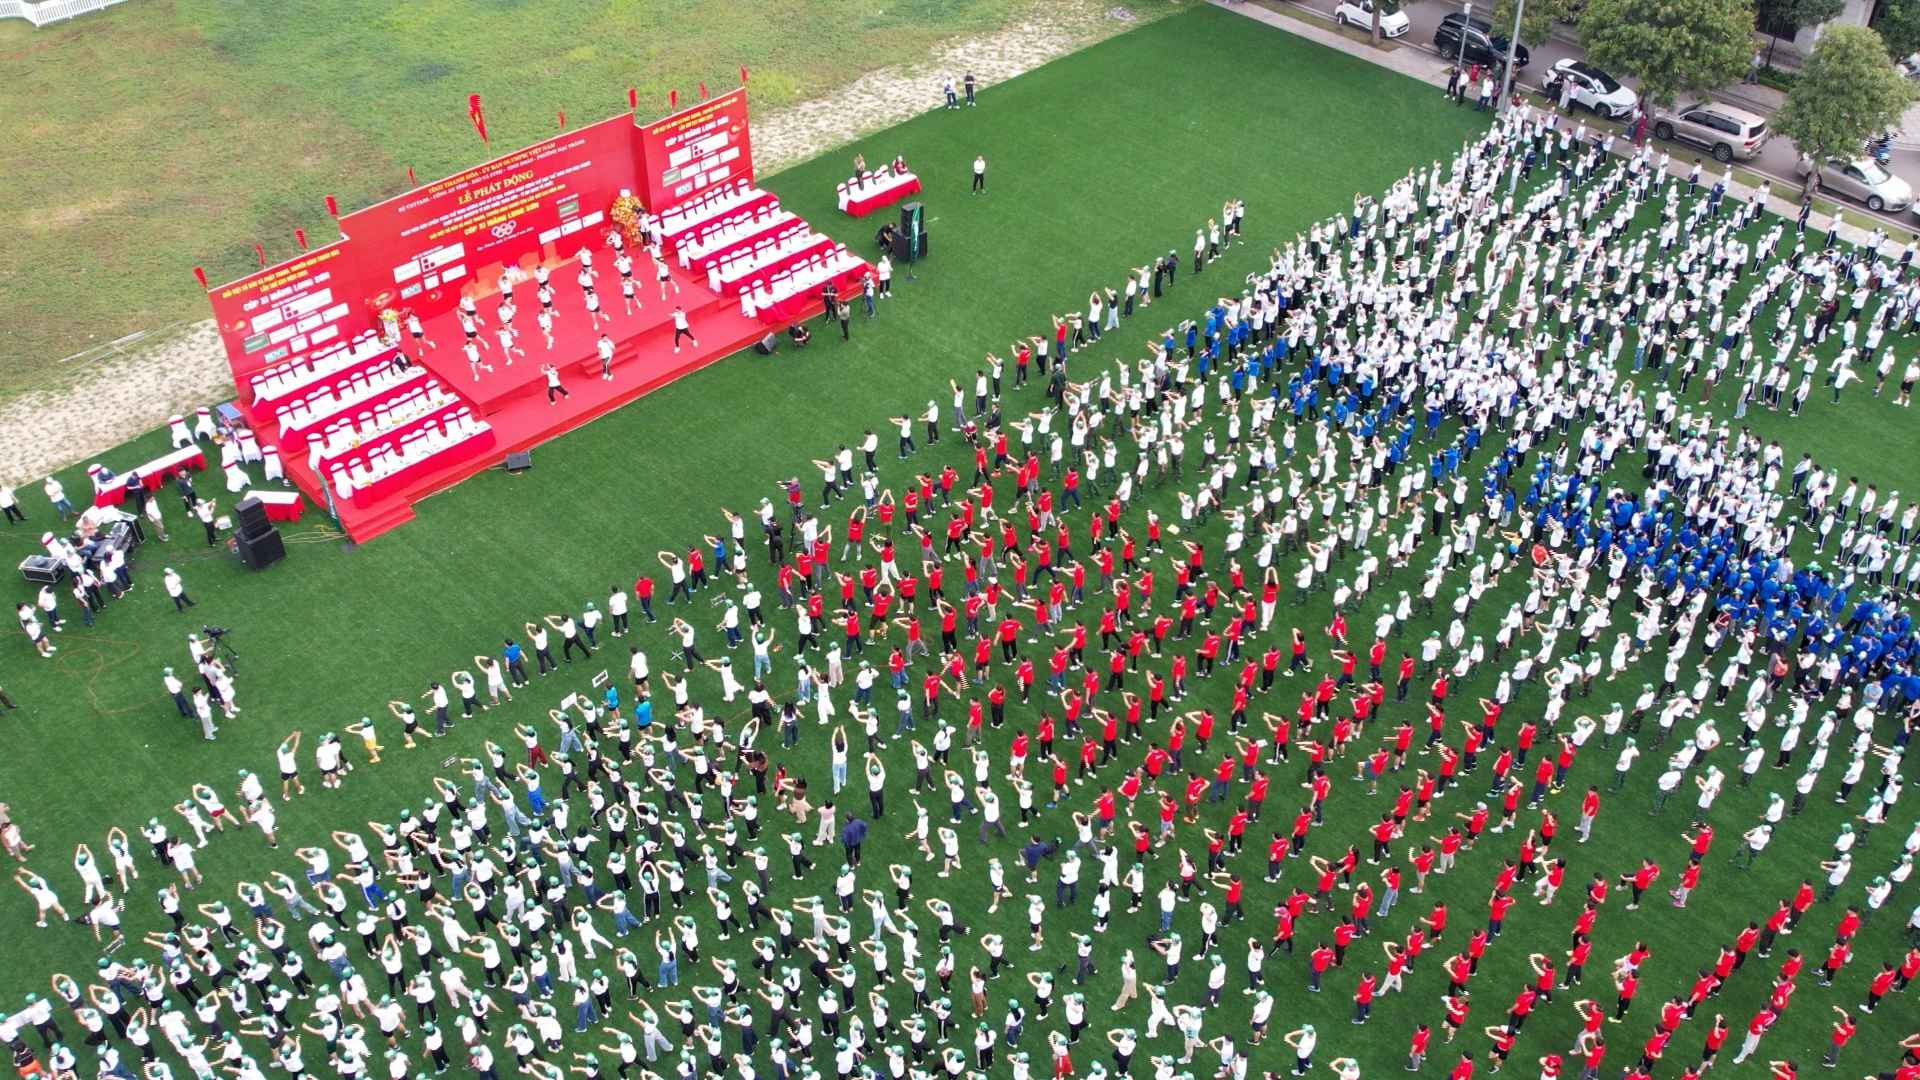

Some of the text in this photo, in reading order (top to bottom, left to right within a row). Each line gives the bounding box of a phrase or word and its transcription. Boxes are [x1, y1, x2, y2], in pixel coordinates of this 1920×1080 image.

[444, 176, 465, 187] THANH
[503, 153, 528, 165] OLYMPIC
[458, 170, 533, 204] LỄ PHÁT ĐỘNG
[464, 226, 477, 235] CÚP
[487, 215, 506, 226] MĂNG
[508, 208, 524, 218] LONG
[526, 202, 539, 211] SƠN
